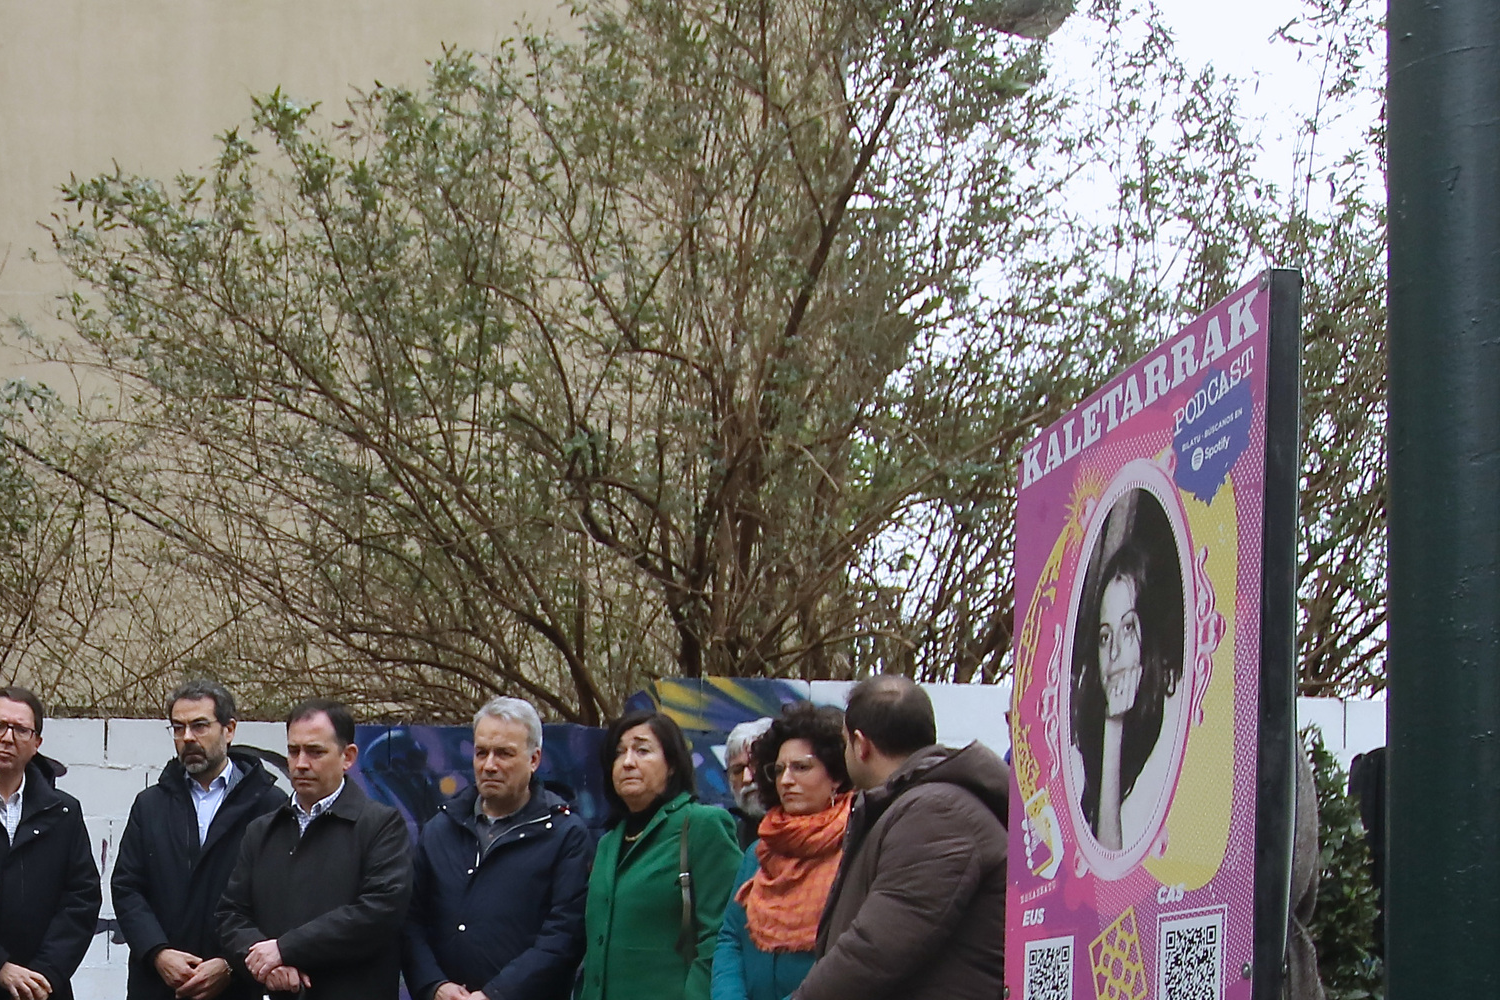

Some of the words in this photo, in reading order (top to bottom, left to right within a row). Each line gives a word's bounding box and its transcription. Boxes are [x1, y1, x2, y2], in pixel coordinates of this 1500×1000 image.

[1022, 288, 1259, 489] KALETARRAK
[1173, 346, 1254, 436] PODCAST
[1182, 435, 1200, 452] BILATU
[1235, 407, 1243, 419] EN
[1205, 435, 1231, 459] Spotify
[1157, 884, 1185, 903] CAS
[1022, 908, 1045, 926] EUS
